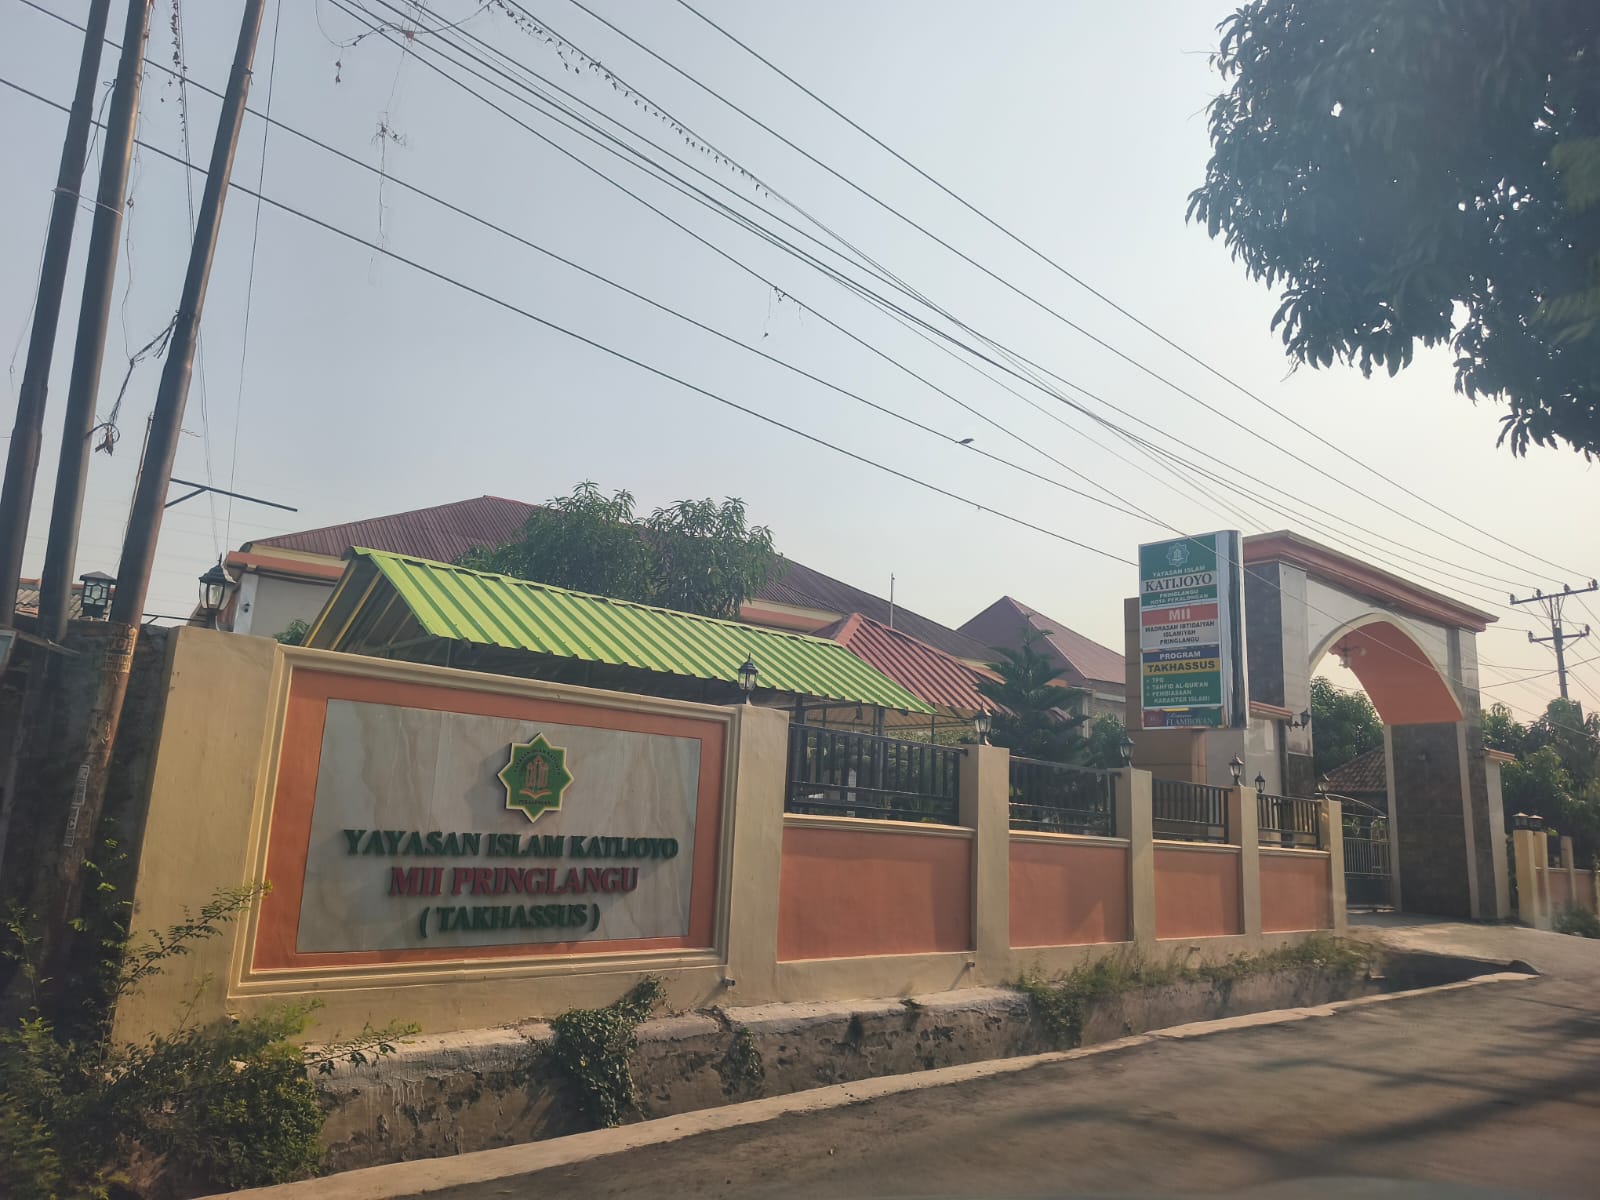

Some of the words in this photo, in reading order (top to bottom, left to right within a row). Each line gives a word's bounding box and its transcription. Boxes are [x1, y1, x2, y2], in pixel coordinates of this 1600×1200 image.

[1153, 569, 1182, 577] YAYASAN
[1146, 573, 1212, 592] KATIJOYO
[1160, 589, 1198, 598] PRINGLANGU
[1169, 608, 1191, 621] MII
[1145, 624, 1178, 632] MADRASAH
[1163, 630, 1196, 638] ISLAMIYAH
[1160, 637, 1200, 645] PRINGLANGU
[1160, 651, 1200, 660] PROGRAM
[1147, 660, 1216, 673] TAKHASSUS
[343, 829, 483, 857] YAYASAN
[486, 833, 565, 858] ISLAM
[569, 835, 680, 860] KATIJOYO
[387, 866, 445, 897] MII
[450, 866, 640, 897] PRINGLANGU
